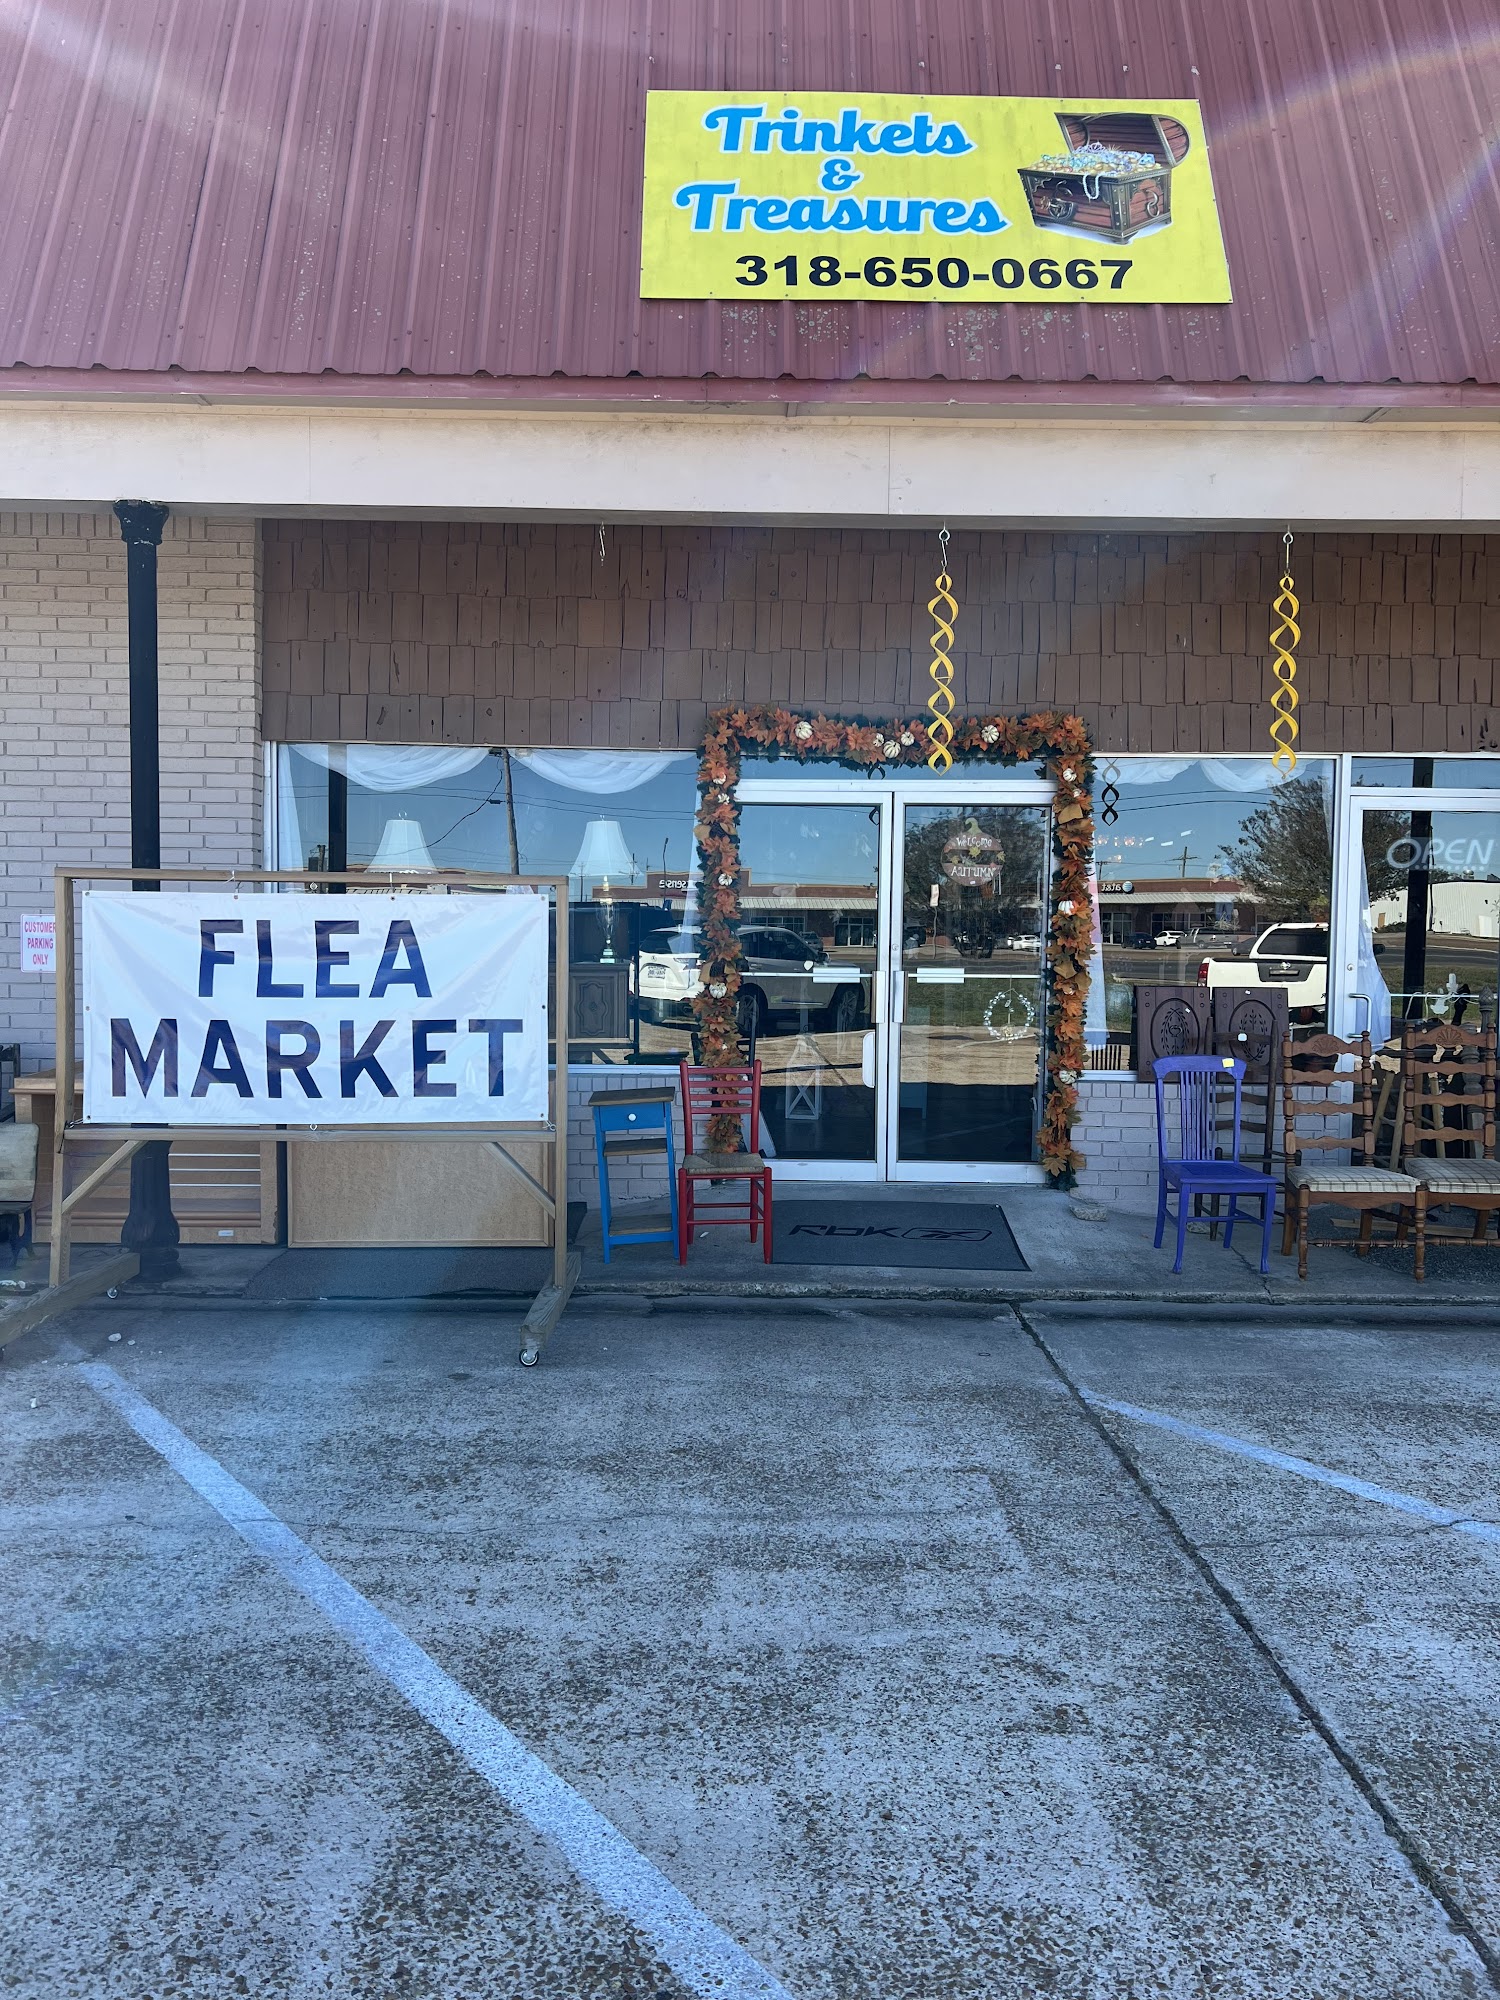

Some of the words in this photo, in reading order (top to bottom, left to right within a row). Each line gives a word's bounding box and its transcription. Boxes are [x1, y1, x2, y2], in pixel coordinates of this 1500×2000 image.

[706, 106, 973, 155] Trinkets
[823, 160, 860, 191] &
[675, 181, 1009, 234] Treasures
[735, 255, 1134, 290] 318-650-0667
[1386, 837, 1495, 869] OPEN
[24, 921, 56, 933] CUSTOMER
[27, 937, 54, 950] PARKING
[32, 953, 49, 965] ONLY
[198, 919, 433, 998] FLEA
[110, 1018, 523, 1099] MARKET
